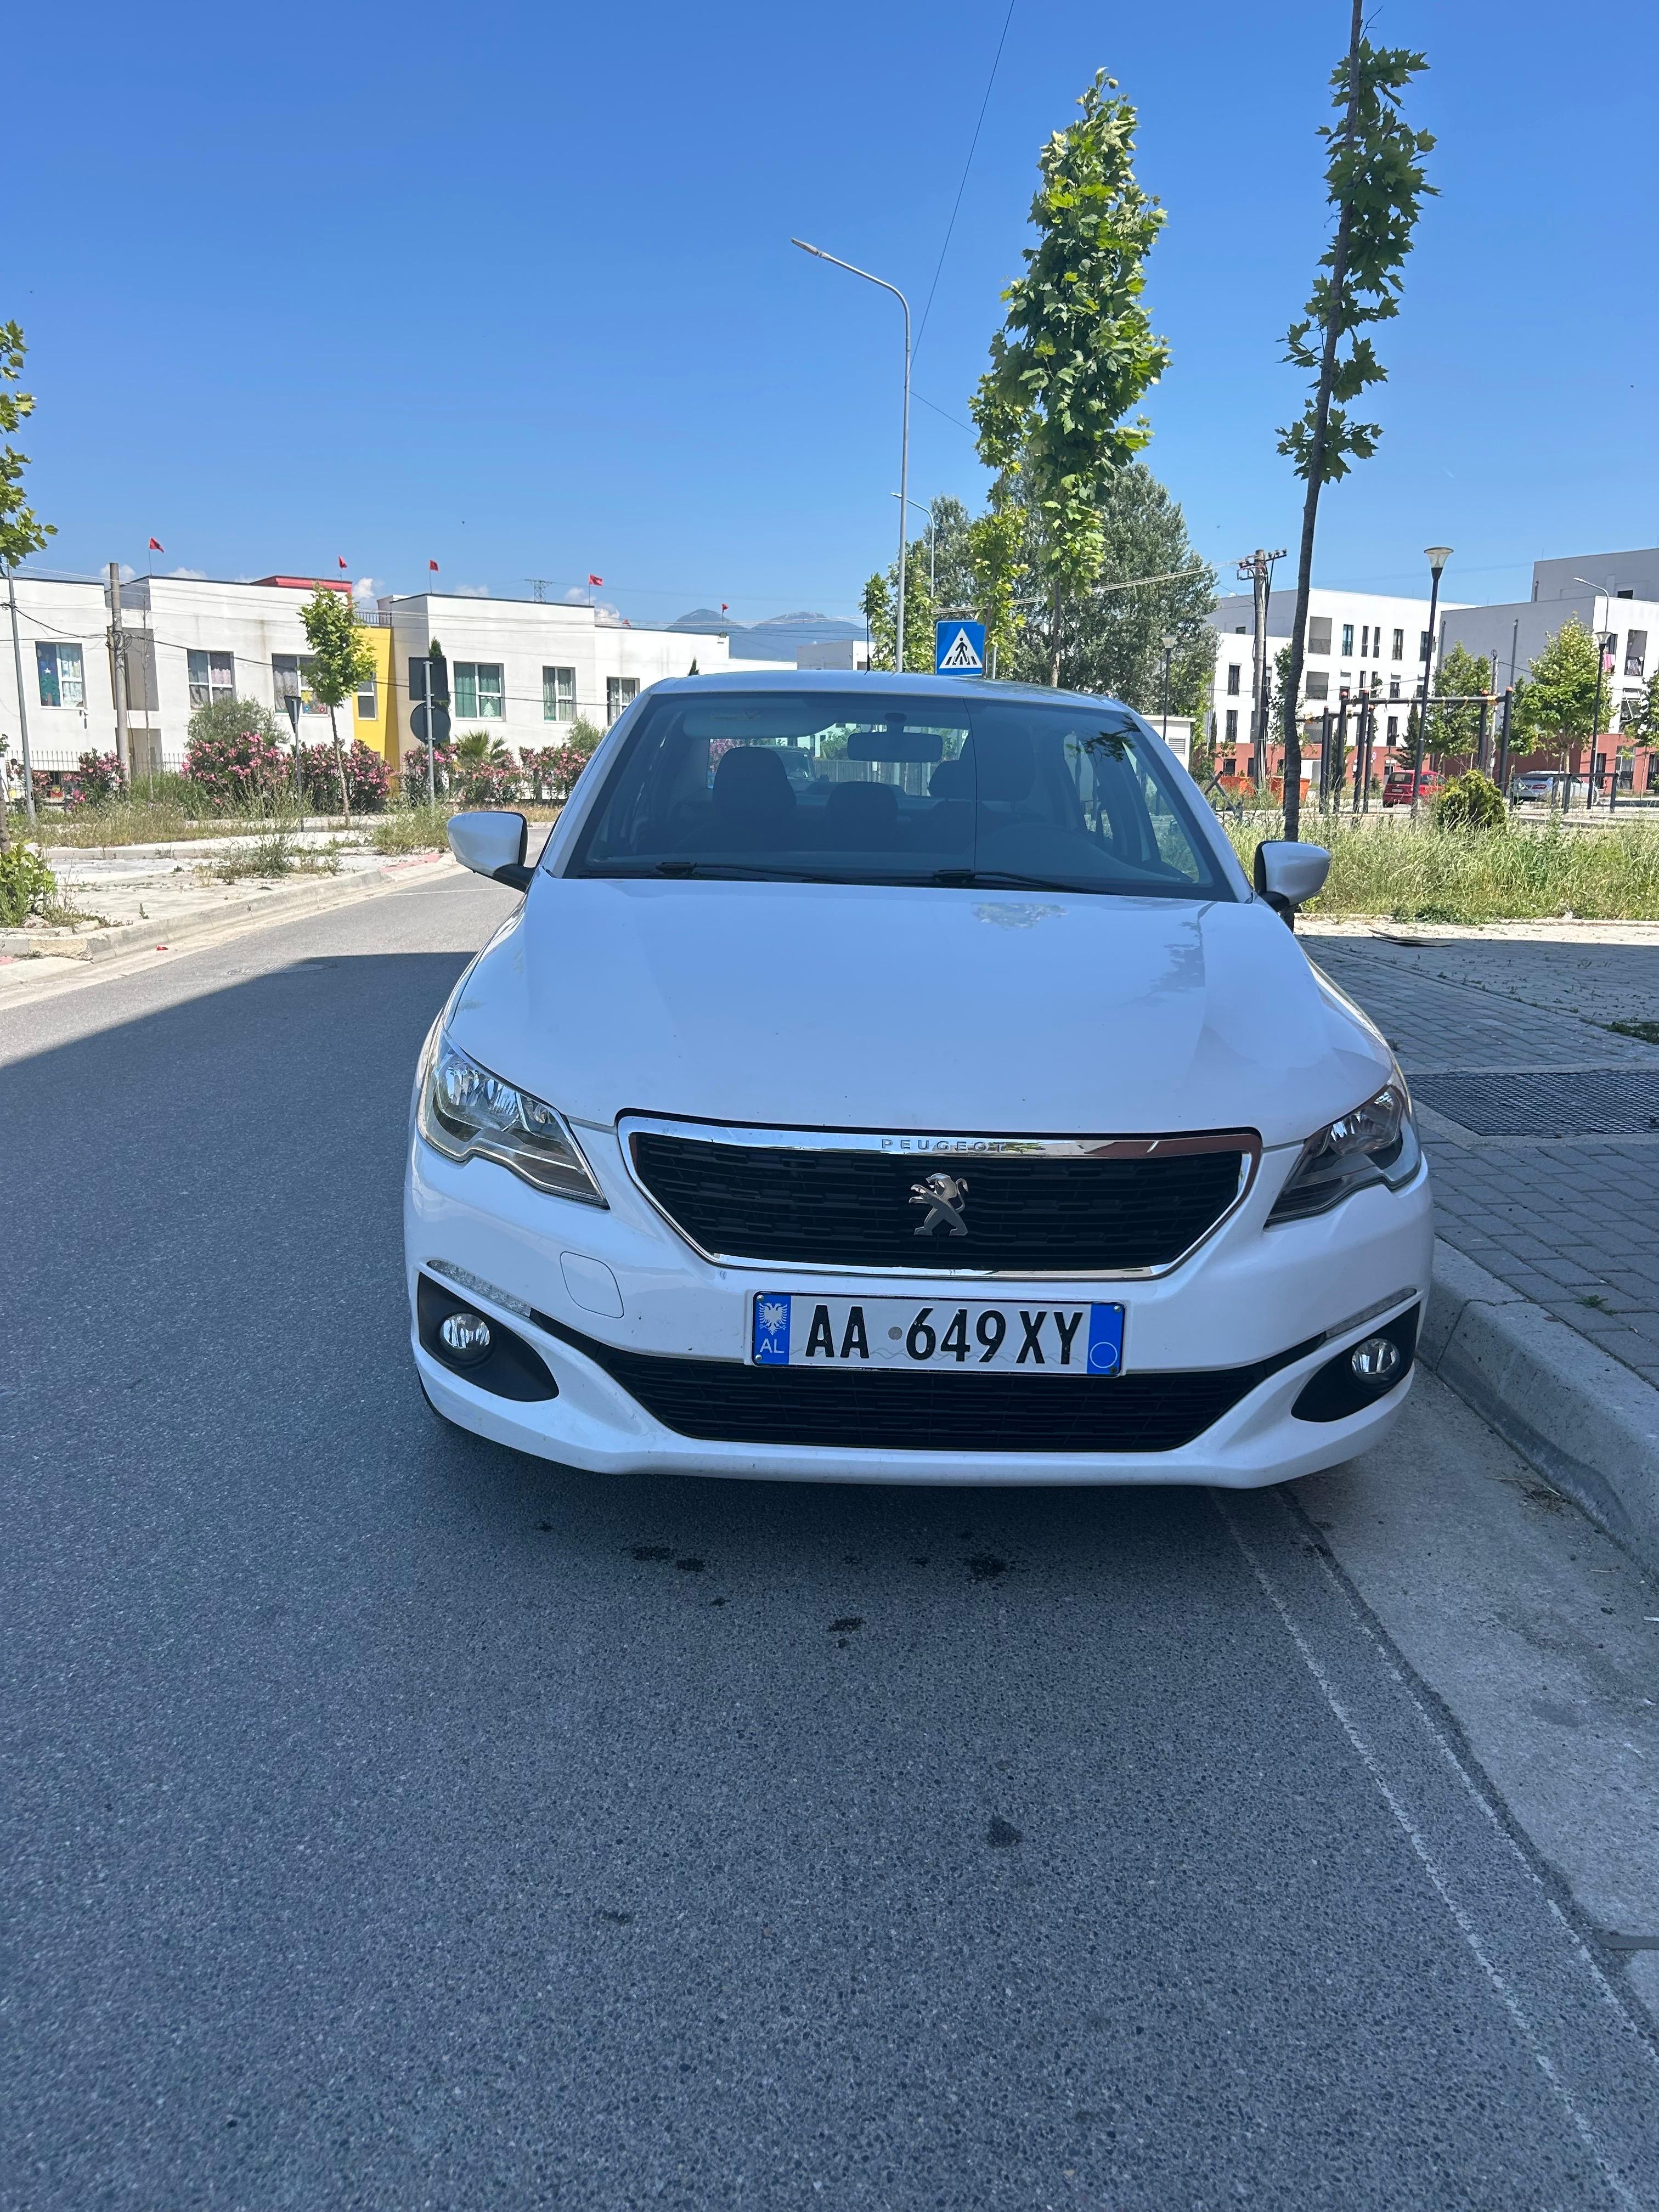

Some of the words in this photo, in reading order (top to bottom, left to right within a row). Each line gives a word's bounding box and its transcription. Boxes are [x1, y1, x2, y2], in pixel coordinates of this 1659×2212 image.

[882, 1138, 1005, 1153] PEUGEOT
[805, 1305, 869, 1358] AA
[759, 1338, 785, 1354] AL
